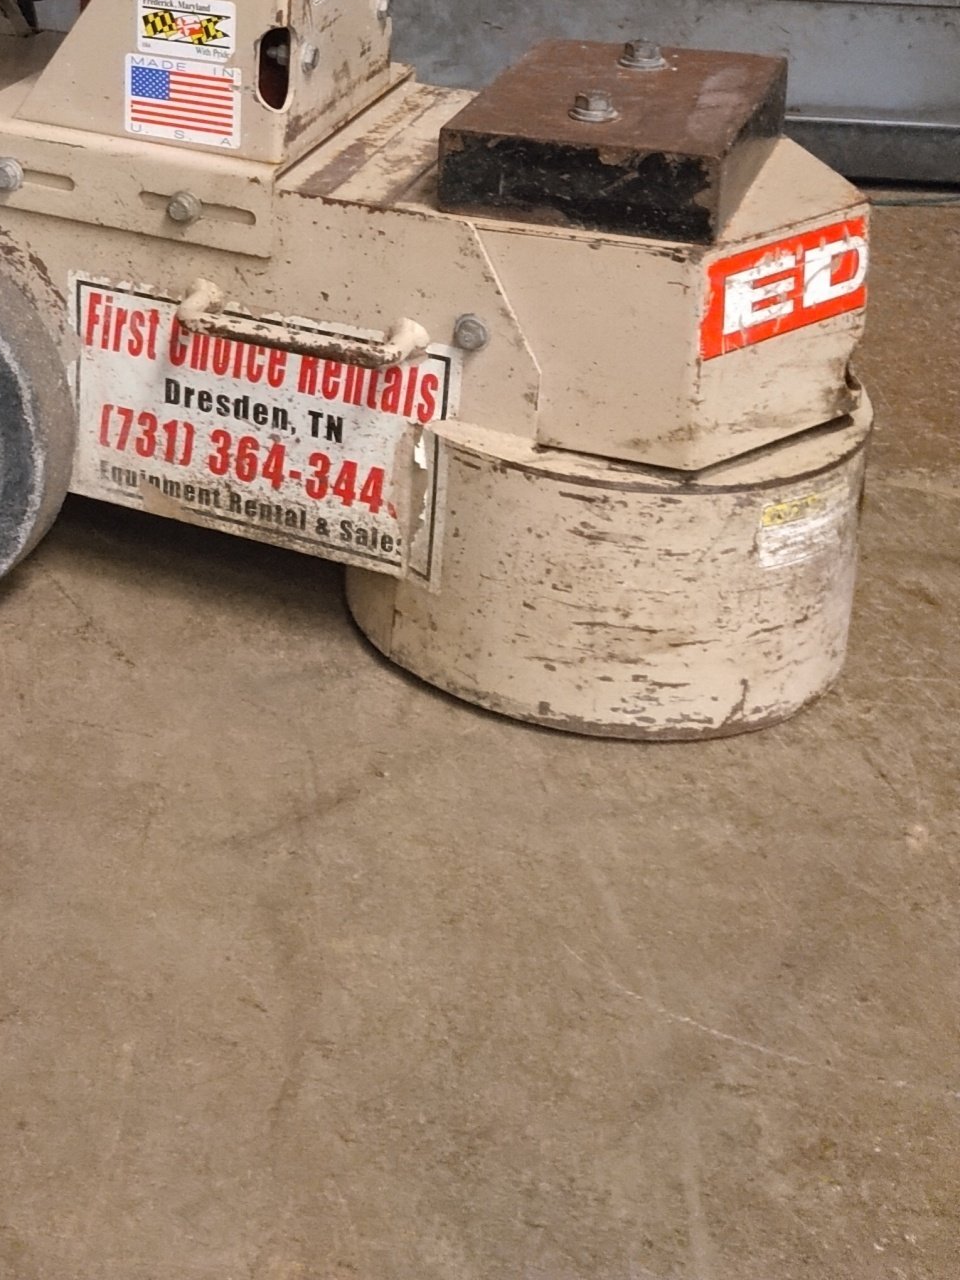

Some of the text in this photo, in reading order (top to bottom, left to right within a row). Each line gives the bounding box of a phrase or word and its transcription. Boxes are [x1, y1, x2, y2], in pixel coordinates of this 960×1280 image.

[130, 56, 235, 78] MADE IN
[84, 291, 440, 425] First Choice Rentals
[164, 377, 344, 444] Dresden, TN
[98, 403, 398, 520] (731) 364-344
[227, 488, 307, 532] Rental
[315, 517, 331, 538] &
